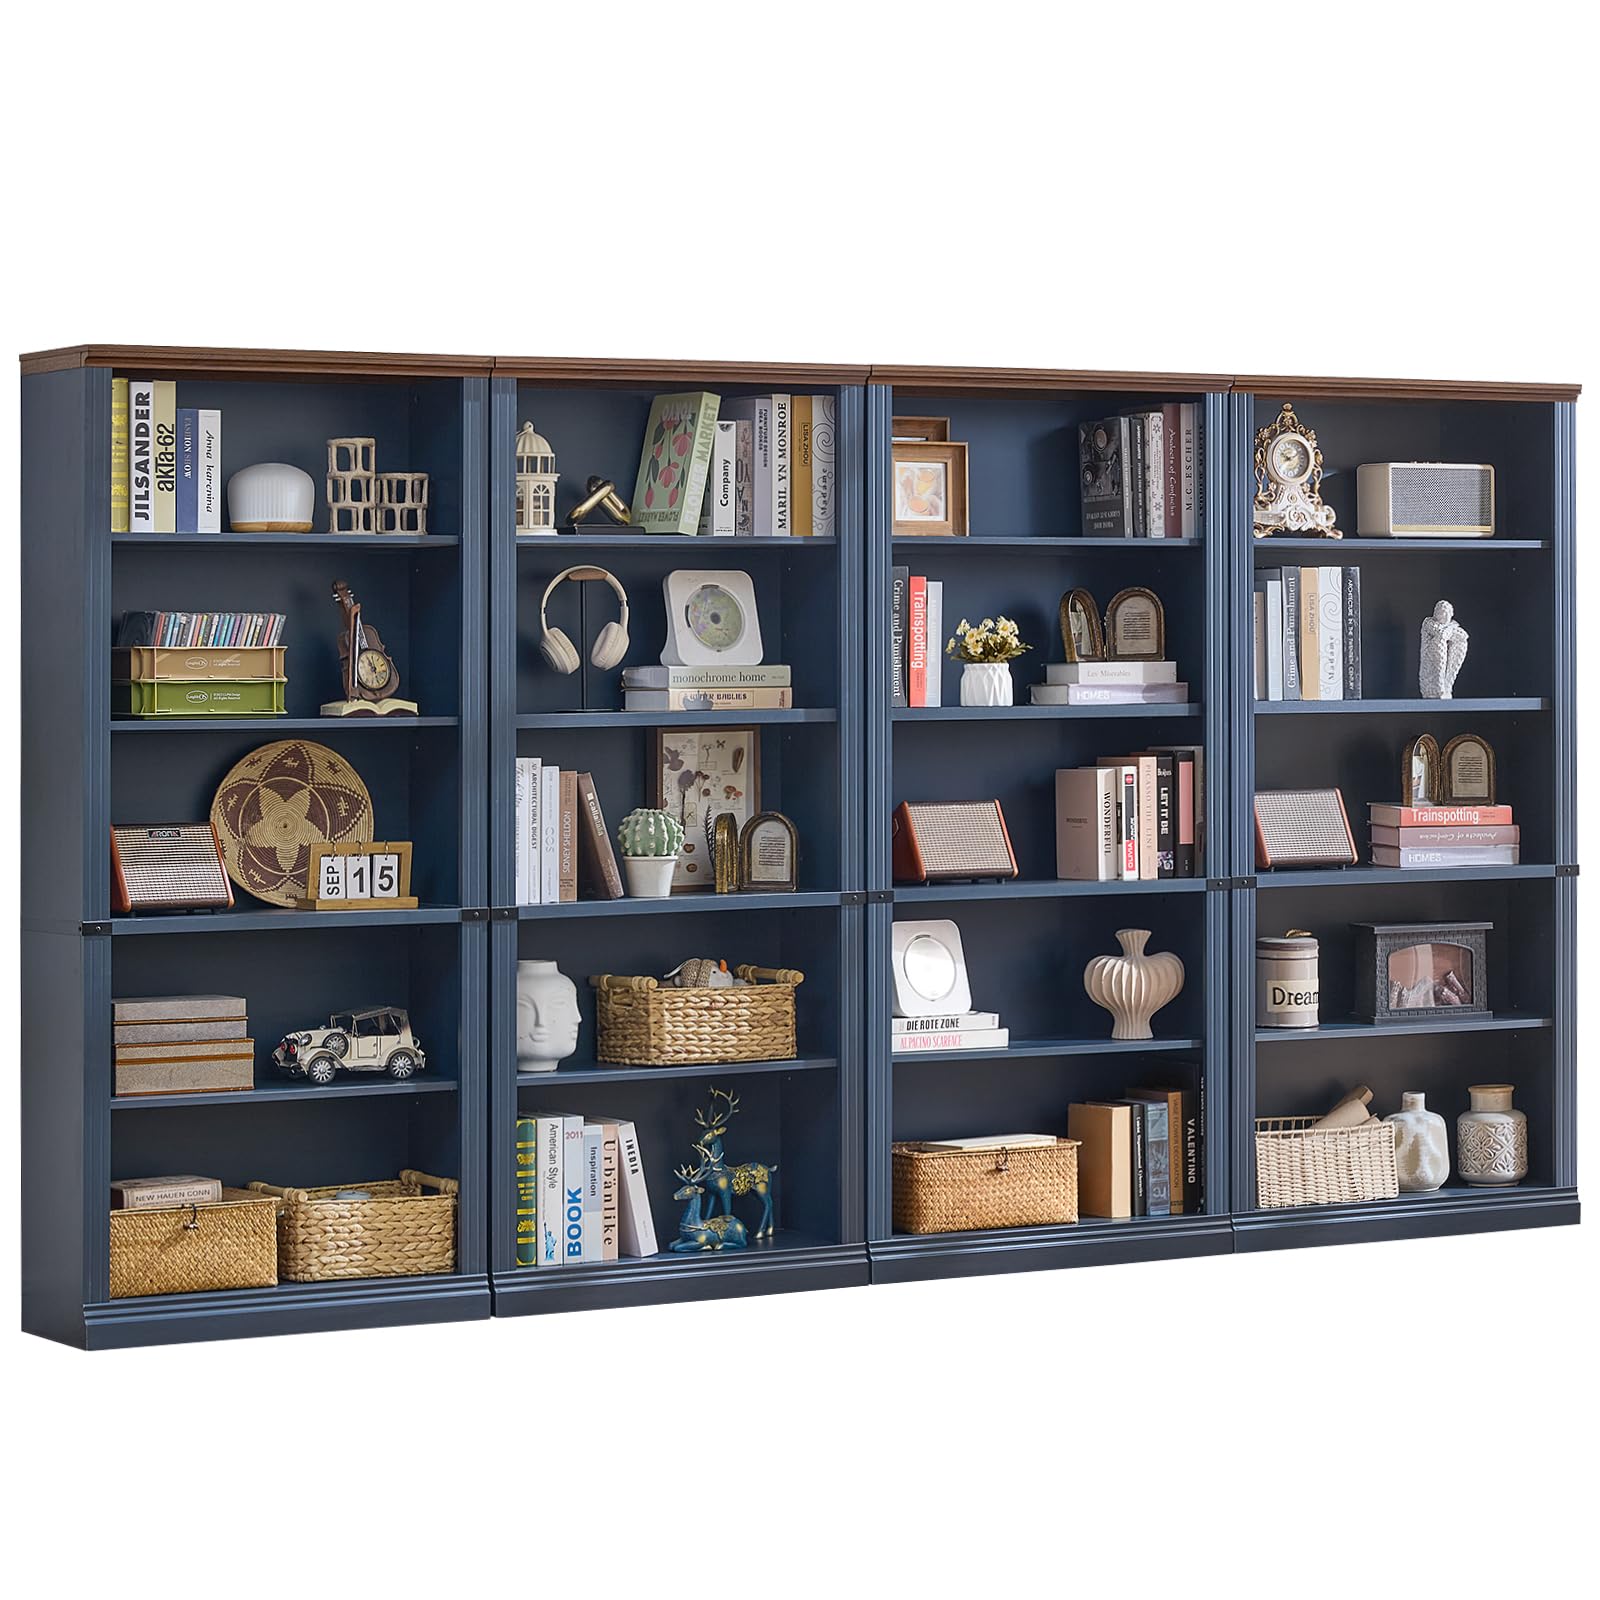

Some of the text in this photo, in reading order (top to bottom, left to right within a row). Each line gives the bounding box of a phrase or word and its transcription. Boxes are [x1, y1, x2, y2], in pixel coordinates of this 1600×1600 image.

[184, 417, 192, 479] FASHION SHOW
[696, 402, 717, 463] MARKET
[777, 402, 787, 459] MONROE
[1168, 428, 1177, 464] Analects
[135, 392, 150, 520] JILSANDER
[206, 430, 215, 513] Anna karenina
[1168, 466, 1177, 474] of
[720, 459, 732, 507] Company
[893, 580, 903, 697] Crime and Punishment
[1286, 577, 1296, 688] Crime and Punishment
[673, 671, 766, 683] monochrome home
[563, 811, 571, 847] SHELDON
[1104, 792, 1112, 856] WONDERFUL
[1160, 787, 1169, 835] LET IT BE
[545, 827, 555, 853] COS
[563, 848, 571, 873] SIDNEY
[1408, 853, 1442, 863] HOMES
[326, 865, 340, 896] SEP
[353, 865, 394, 893] 1 5
[906, 1018, 960, 1030] DIE ROTE ZONE
[548, 1123, 559, 1189] American Style
[565, 1131, 583, 1140] 2011
[625, 1139, 640, 1175] INEDIA
[1187, 1118, 1196, 1184] VALENTINO
[135, 1194, 155, 1202] NEW
[187, 1189, 211, 1197] CONN
[589, 1146, 598, 1197] Inspiration
[567, 1187, 583, 1257] BOOK
